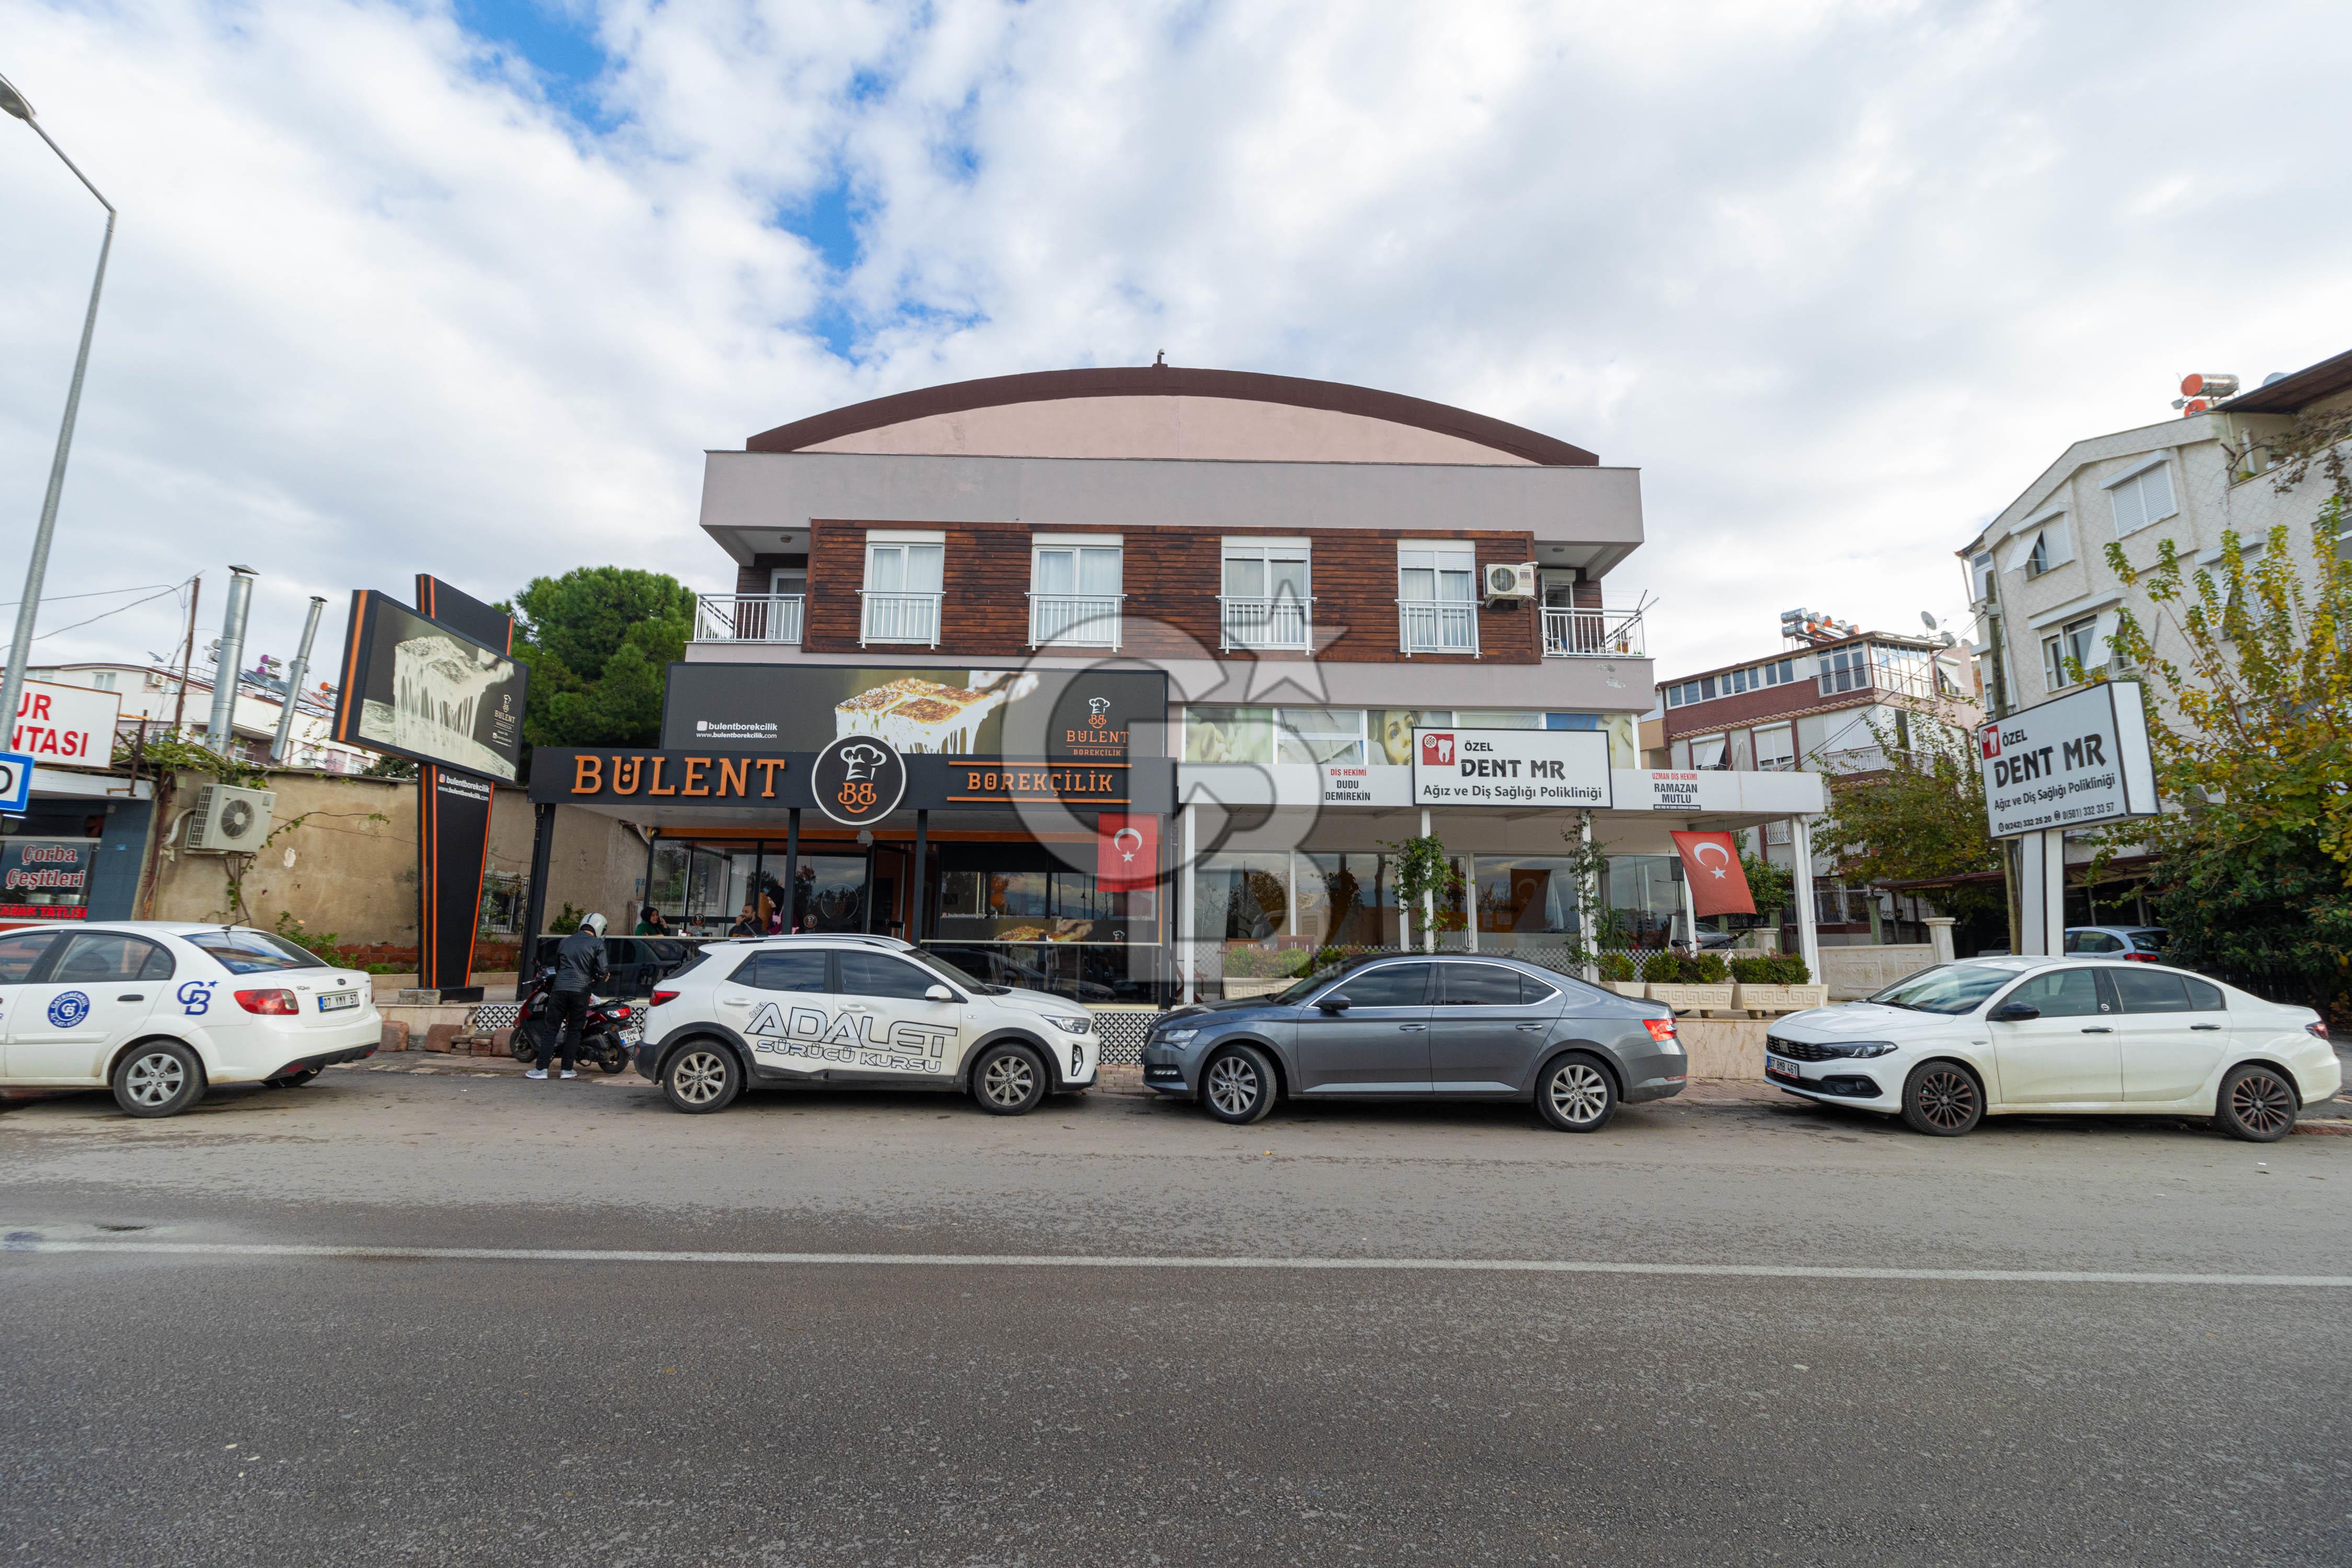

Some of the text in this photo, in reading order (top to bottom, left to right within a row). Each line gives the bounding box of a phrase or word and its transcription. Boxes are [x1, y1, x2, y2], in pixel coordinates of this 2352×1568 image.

[709, 722, 778, 731] bulentborekcilik
[1066, 730, 1129, 743] BÜLENT
[2002, 729, 2028, 747] ÖZEL
[1465, 740, 1493, 752] ÖZEL
[1993, 733, 2106, 788] DENT MR
[571, 755, 785, 797] BÜLENT
[1331, 767, 1367, 776] DİŞ HEKİMİ
[1461, 759, 1566, 780] DENT MR
[1671, 771, 1679, 781] DİŞ
[1680, 771, 1698, 780] HEKİMİ
[446, 775, 490, 793] bulentborekcilik
[967, 770, 1113, 797] BÖREKÇİLİK
[1336, 780, 1359, 789] DUDU
[1654, 783, 1698, 793] RAMAZAN
[1325, 790, 1370, 801] DEMİREKİN
[1423, 785, 1450, 799] Ağız
[1472, 785, 1491, 799] Diş
[1494, 786, 1536, 800] Sağlığı
[1540, 786, 1602, 801] Polikliniği
[1662, 794, 1691, 803] MUTLU
[1994, 773, 2115, 811] Ağız ve Diş Sağlığı Polikliniği
[2083, 806, 2095, 816] 332
[2096, 804, 2105, 814] 33
[2106, 802, 2114, 812] 57
[2023, 818, 2034, 827] 332
[21, 845, 78, 865] Çorba
[6, 869, 86, 890] Çeşitleri
[350, 994, 357, 1004] 57
[743, 1002, 958, 1058] ADALET
[755, 1038, 941, 1073] SÜRÜCÜ KURSU
